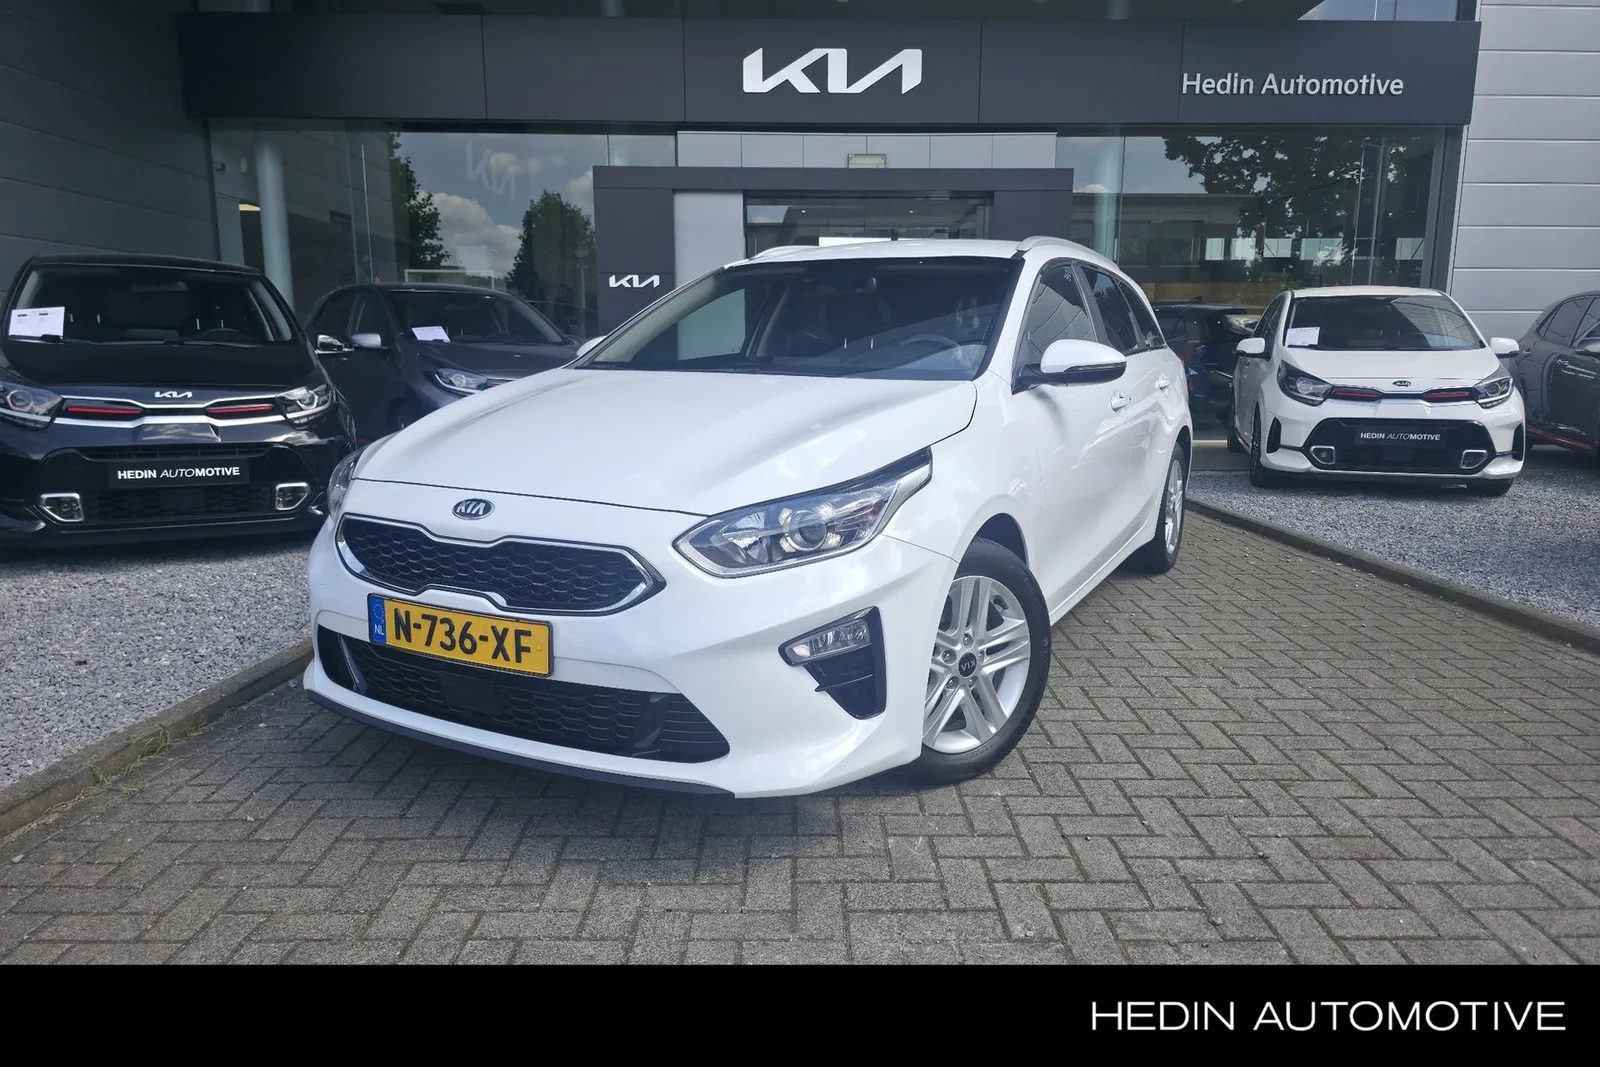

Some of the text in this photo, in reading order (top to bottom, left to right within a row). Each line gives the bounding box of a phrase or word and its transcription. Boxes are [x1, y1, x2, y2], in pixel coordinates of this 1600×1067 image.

[743, 47, 923, 95] KIA
[1181, 72, 1404, 95] Hedin Automotive
[609, 274, 660, 288] KIA
[1386, 433, 1441, 441] AUTOMOTIVE
[117, 467, 240, 479] HEDIN AUTOMOTIVE
[456, 500, 486, 515] KIA
[374, 623, 385, 636] NL
[393, 607, 533, 664] N-736-XF
